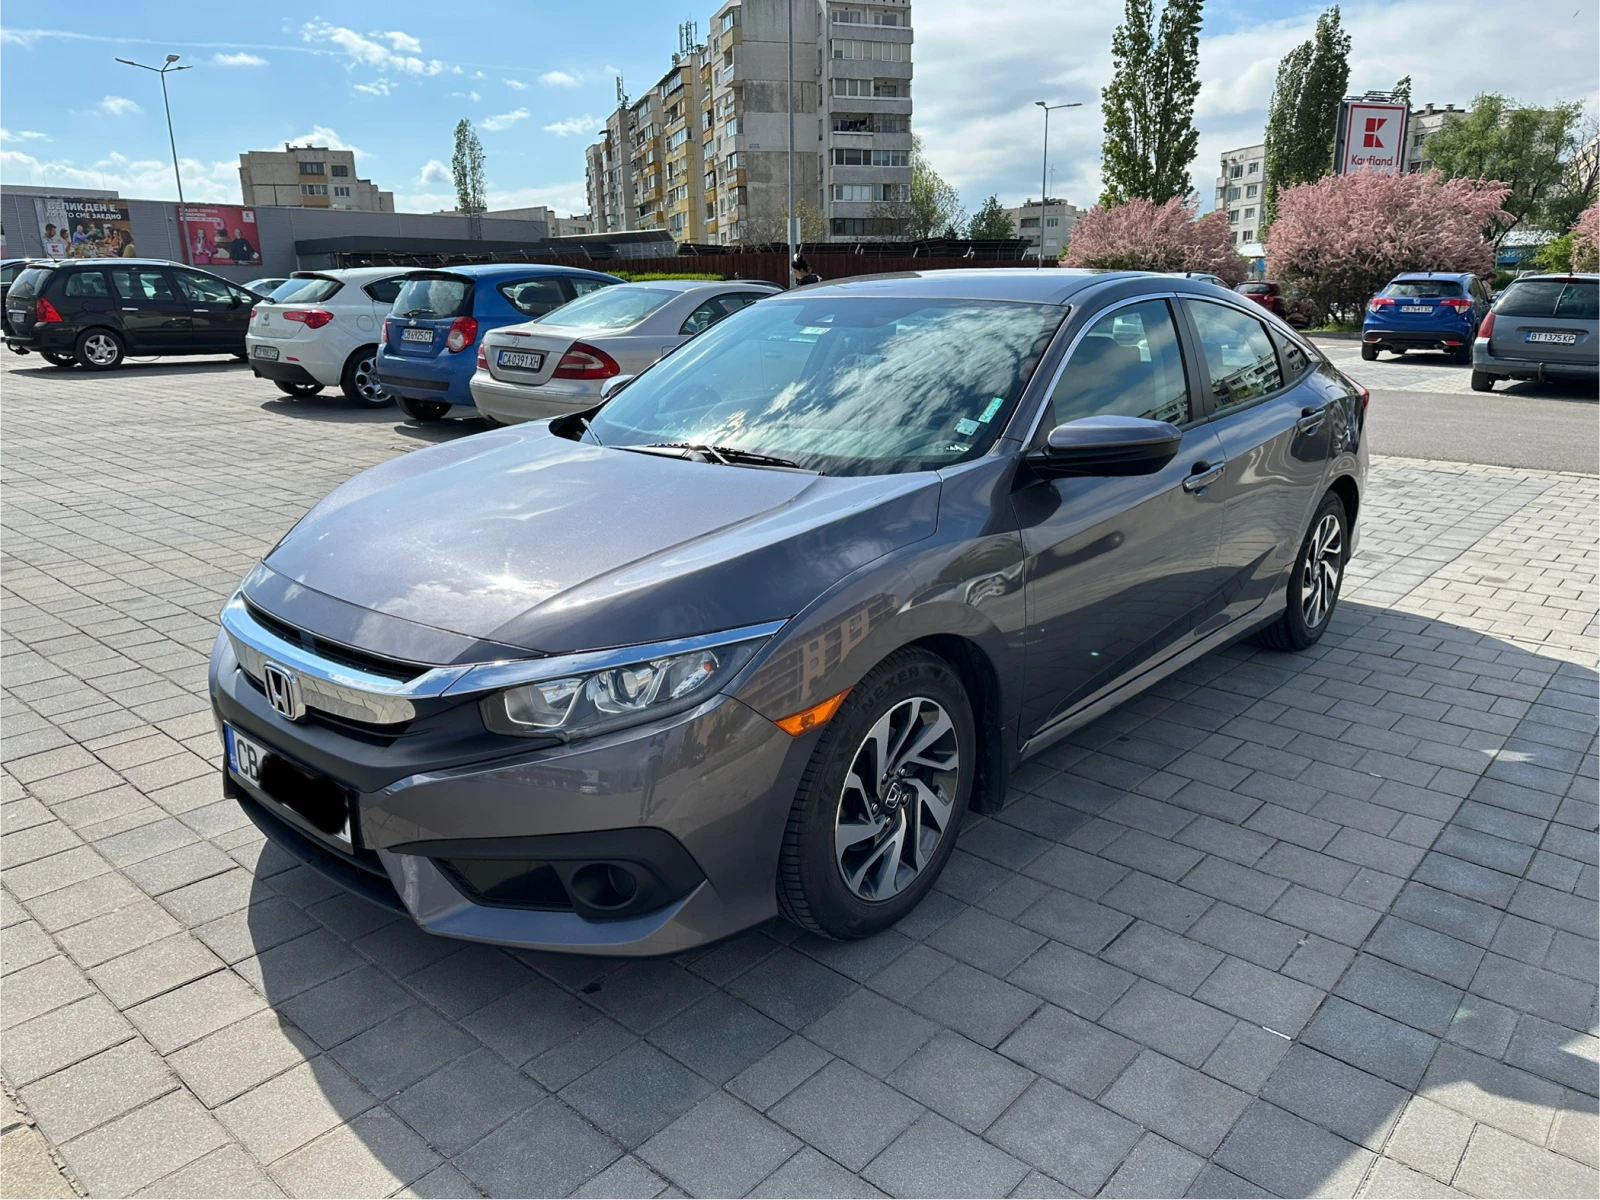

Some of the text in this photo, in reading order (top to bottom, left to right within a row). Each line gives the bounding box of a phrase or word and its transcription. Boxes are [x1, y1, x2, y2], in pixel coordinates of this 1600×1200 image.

[47, 202, 107, 212] ВЕЛИКДЕН
[92, 212, 122, 220] ЗАЕДНО
[1531, 333, 1575, 343] BT 1375 KP
[511, 354, 528, 367] 0391
[529, 355, 540, 368] XH
[861, 666, 920, 714] NEXEN
[236, 738, 260, 783] CB
